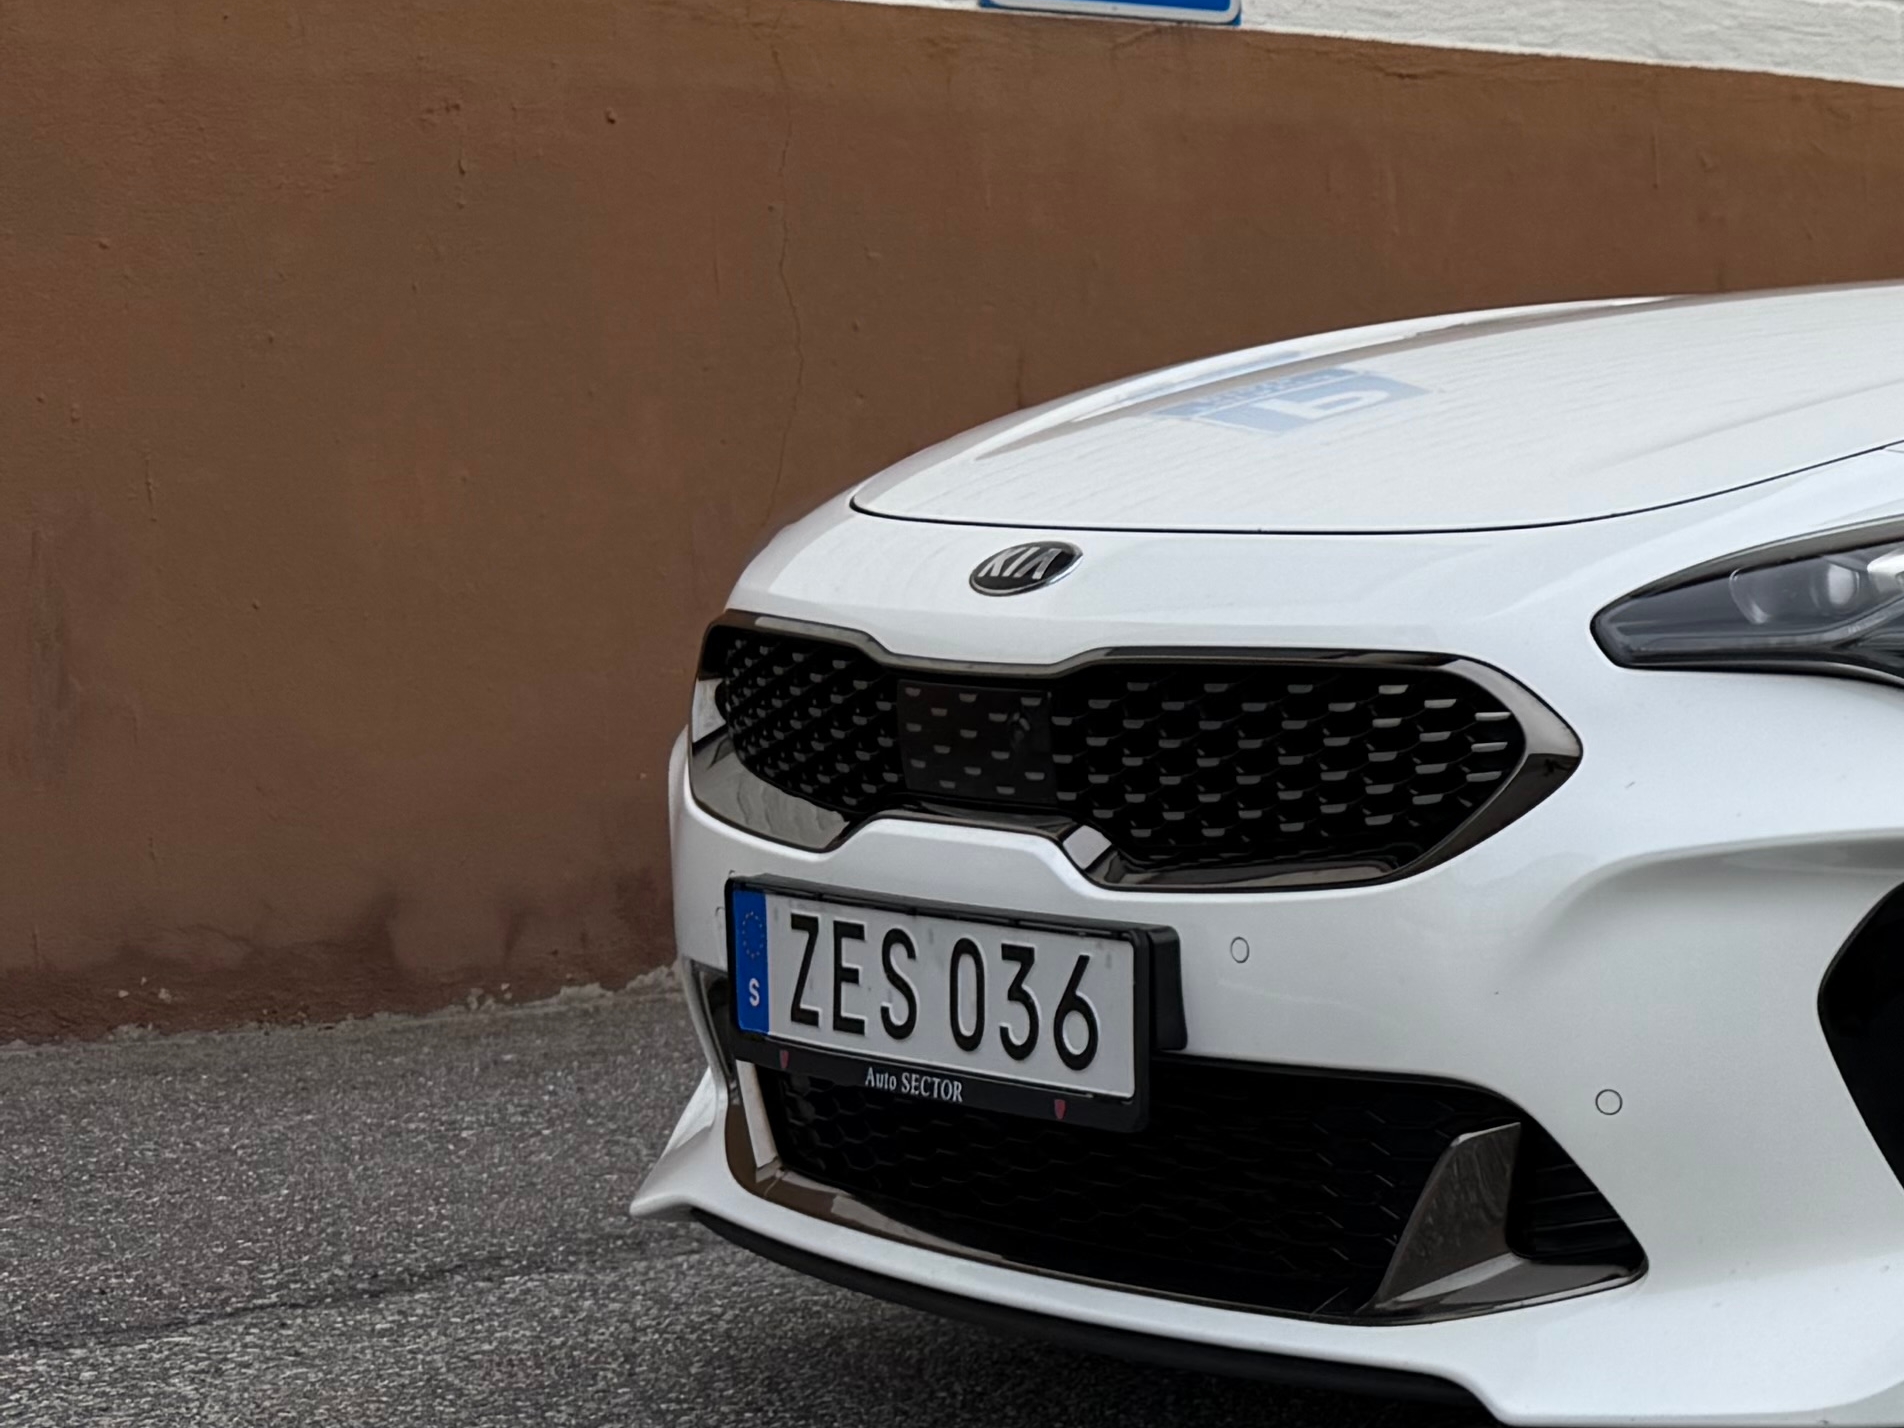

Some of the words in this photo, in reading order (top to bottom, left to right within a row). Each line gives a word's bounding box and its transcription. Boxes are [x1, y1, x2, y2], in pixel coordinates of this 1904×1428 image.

[977, 545, 1063, 580] KIA
[748, 977, 761, 1007] S
[790, 912, 918, 1041] ZES
[949, 937, 1100, 1071] 036
[864, 1066, 898, 1092] Auto
[901, 1071, 963, 1103] SECTOR
